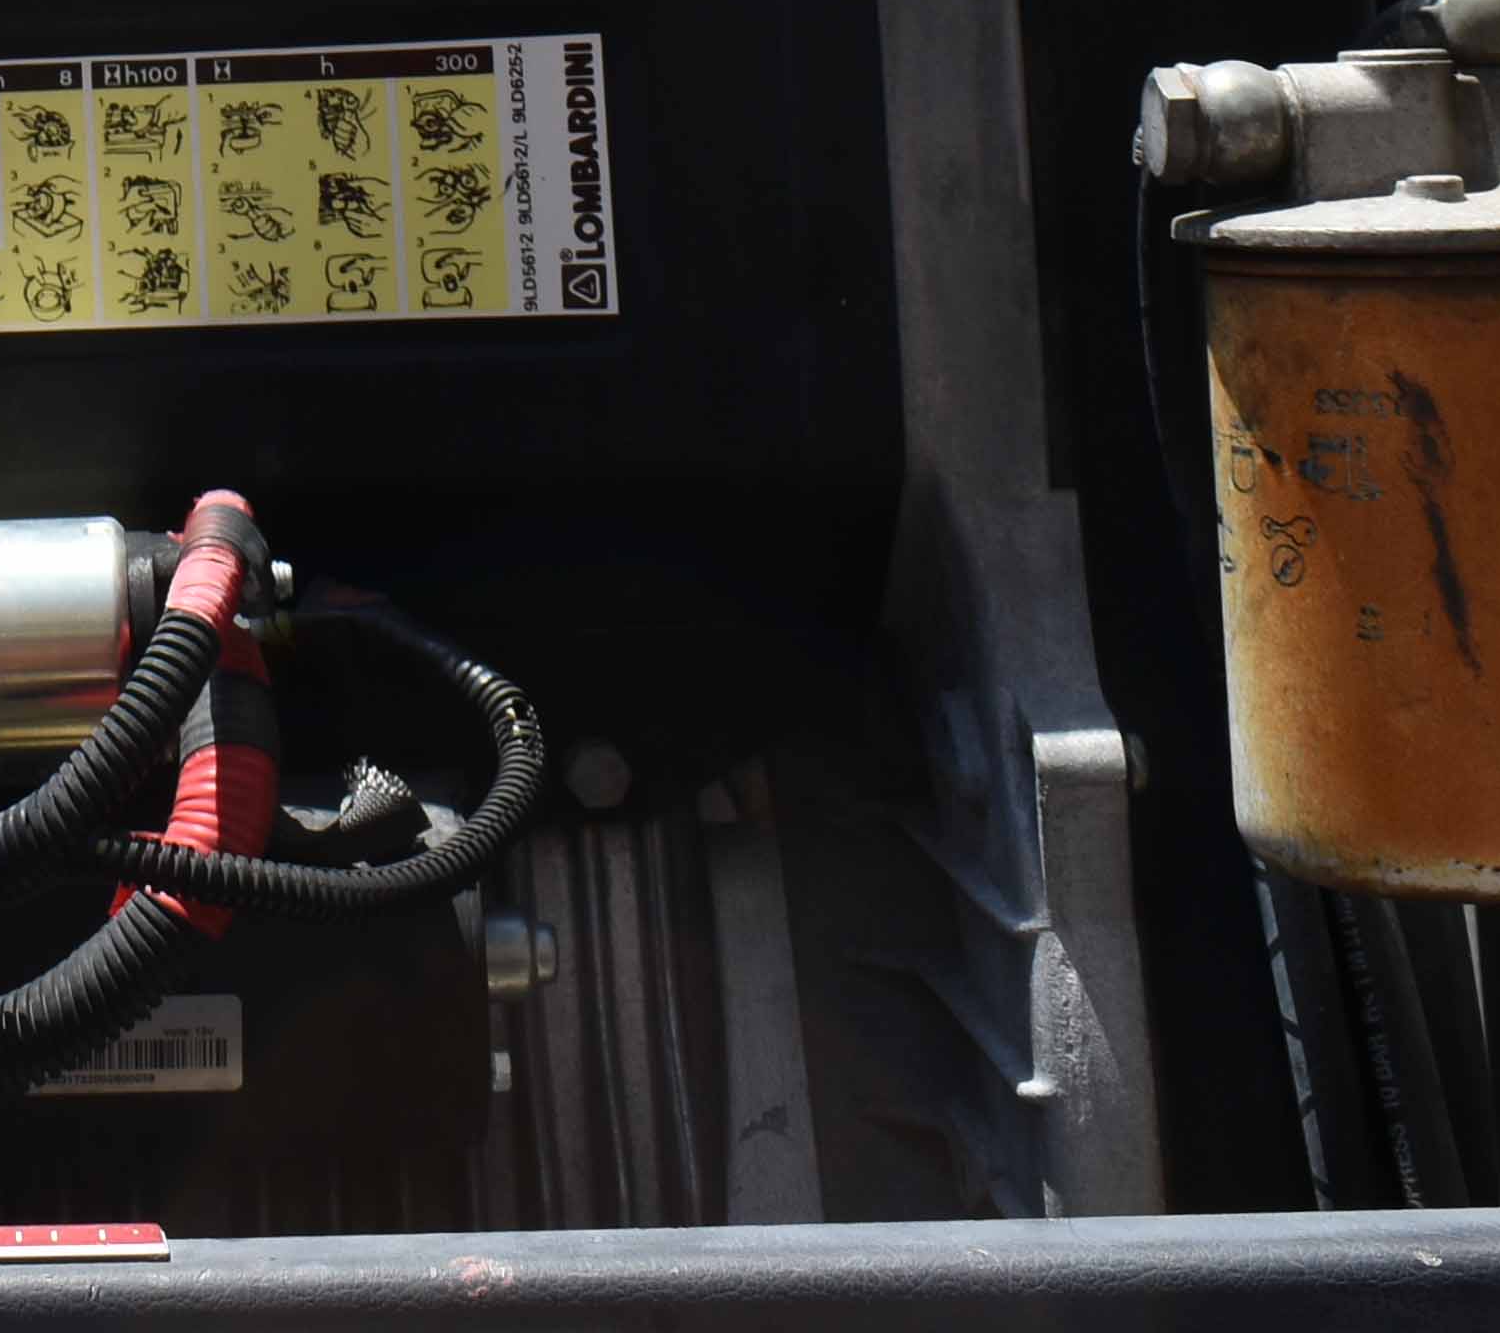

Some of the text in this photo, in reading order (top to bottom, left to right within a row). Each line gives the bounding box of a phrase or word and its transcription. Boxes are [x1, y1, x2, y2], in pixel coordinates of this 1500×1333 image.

[320, 53, 478, 76] h 300
[59, 70, 73, 85] 8
[564, 42, 606, 260] LOMBARDINI
